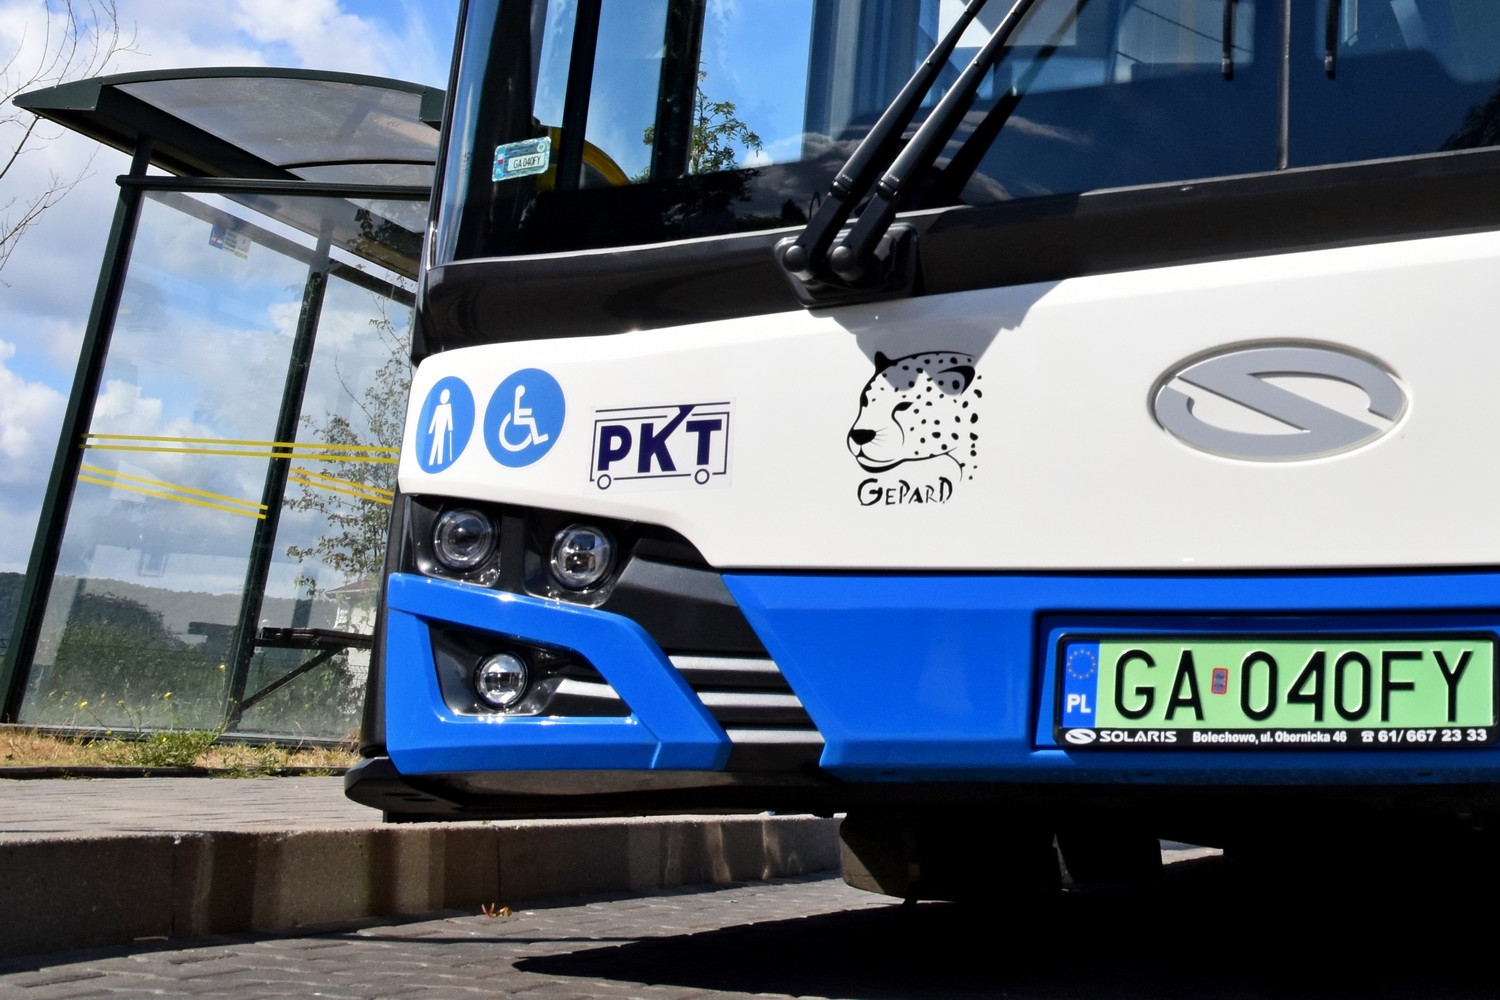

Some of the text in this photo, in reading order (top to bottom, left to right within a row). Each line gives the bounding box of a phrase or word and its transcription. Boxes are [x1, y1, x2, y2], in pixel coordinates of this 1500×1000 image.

[597, 403, 722, 474] PKT
[1114, 648, 1475, 722] GA 040FY
[1066, 693, 1092, 714] PL
[1099, 730, 1178, 743] SOLARIS
[1192, 731, 1347, 745] Bolechowo, ul. Obornicka 46
[1440, 729, 1463, 743] 23
[1466, 728, 1488, 742] 33
